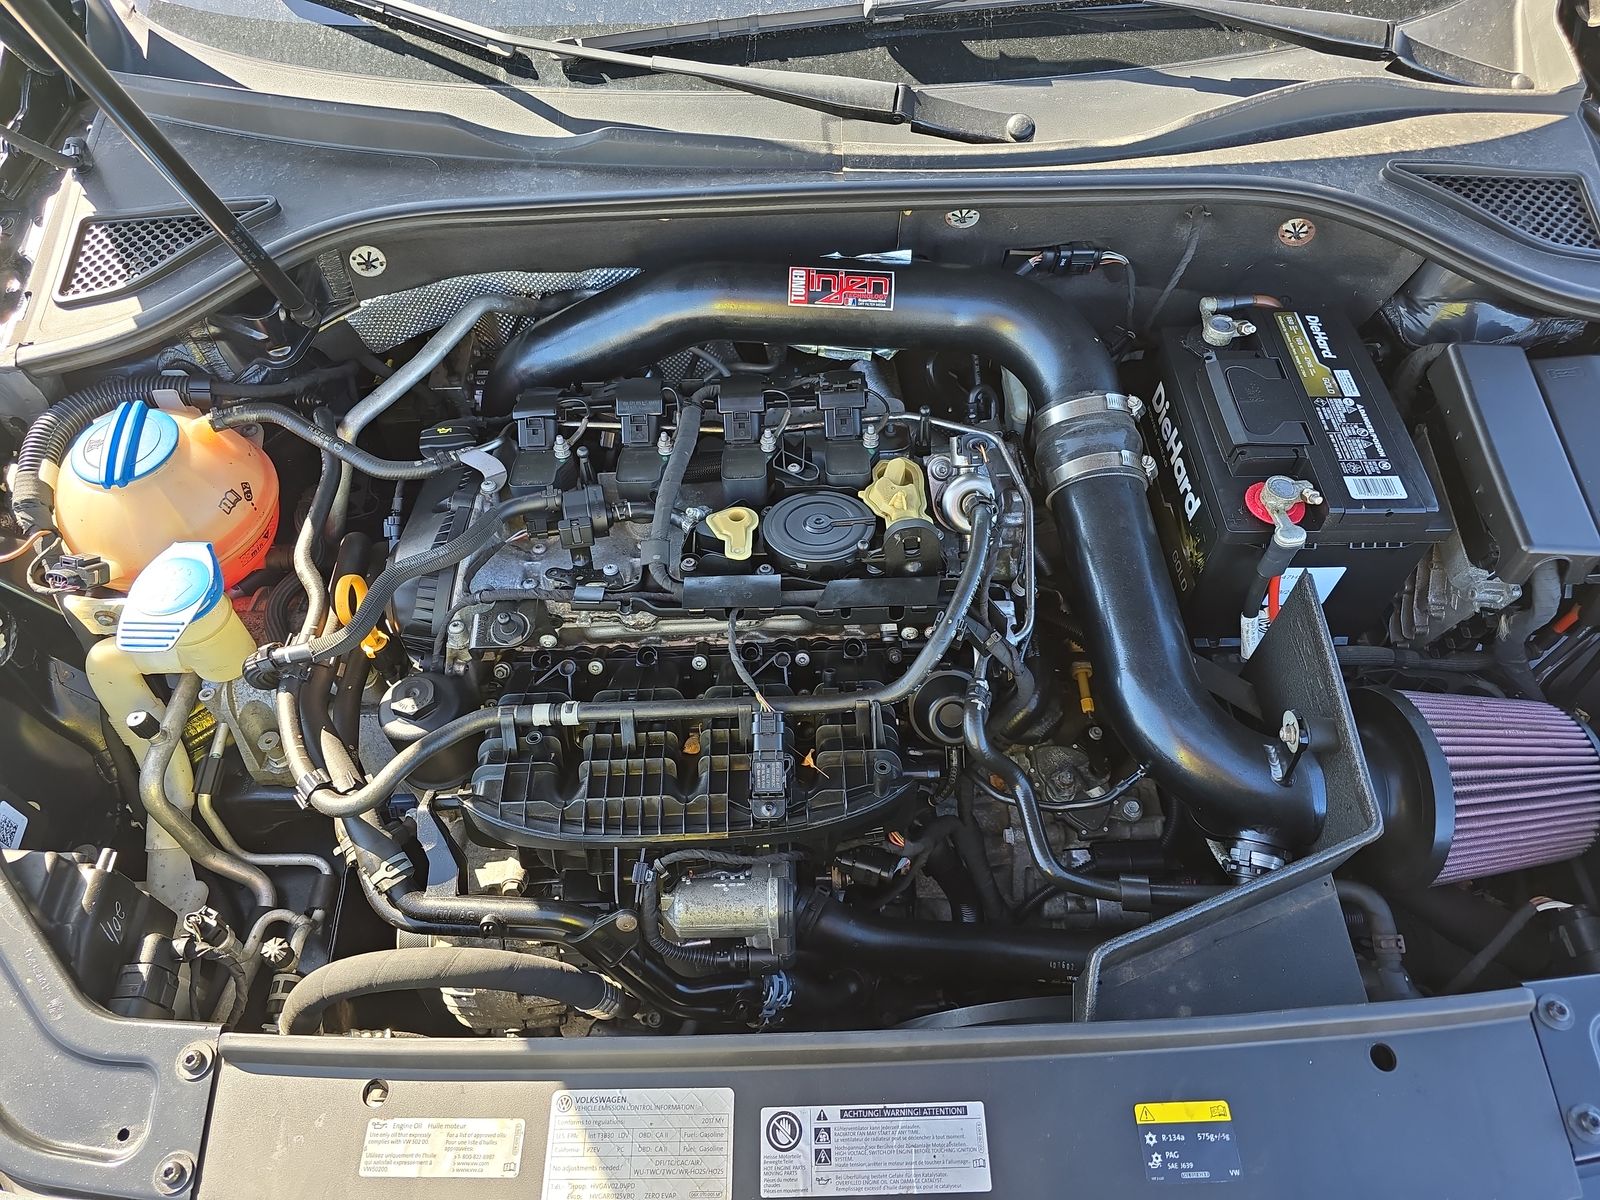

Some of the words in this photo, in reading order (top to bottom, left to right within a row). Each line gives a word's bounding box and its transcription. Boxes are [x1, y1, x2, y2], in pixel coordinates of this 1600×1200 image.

[791, 270, 806, 301] TUNED
[809, 269, 890, 305] injen
[1305, 315, 1337, 359] DieHard
[1322, 377, 1335, 395] GOLD
[1152, 381, 1201, 522] DieHard
[1172, 550, 1188, 592] GOLD
[575, 1096, 627, 1104] VOLKSWAGEN
[843, 1110, 882, 1118] ACHTUNG!
[883, 1108, 920, 1116] WARNING!
[922, 1107, 966, 1115] ATTENTION!
[393, 1122, 412, 1131] Engine
[413, 1122, 423, 1130] Oil
[1161, 1134, 1185, 1142] R-134a
[1165, 1151, 1180, 1159] PAG
[1229, 1169, 1240, 1177] VW
